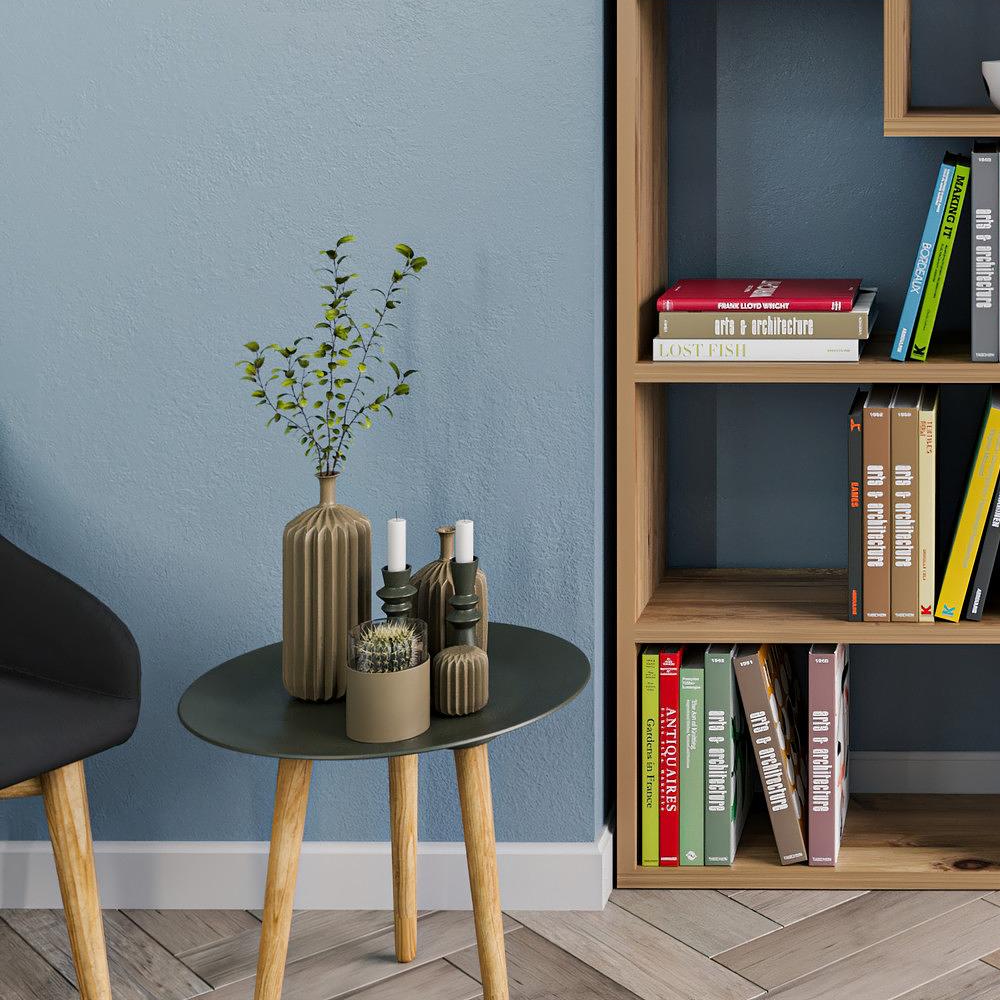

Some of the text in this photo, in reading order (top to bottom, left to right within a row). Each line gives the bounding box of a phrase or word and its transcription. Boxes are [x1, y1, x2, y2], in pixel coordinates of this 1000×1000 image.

[946, 175, 965, 223] MAKING
[976, 208, 993, 229] arts
[943, 225, 953, 239] IT
[910, 243, 932, 294] BORDEAUX
[976, 246, 995, 308] architecture
[714, 315, 813, 336] arts & architecture
[717, 302, 790, 310] FRANK LLOYD WRIGHT
[659, 343, 746, 357] LOST FISH
[866, 465, 885, 485] arts
[895, 465, 913, 485] arts
[866, 503, 887, 567] architecture
[895, 503, 915, 567] architecture
[749, 711, 768, 733] arts
[813, 711, 831, 731] arts
[646, 718, 655, 808] Gardens in France
[663, 707, 677, 812] ANTIQUAIRES
[709, 710, 729, 811] arts & architecture
[758, 748, 789, 811] architecture
[813, 748, 832, 812] architecture
